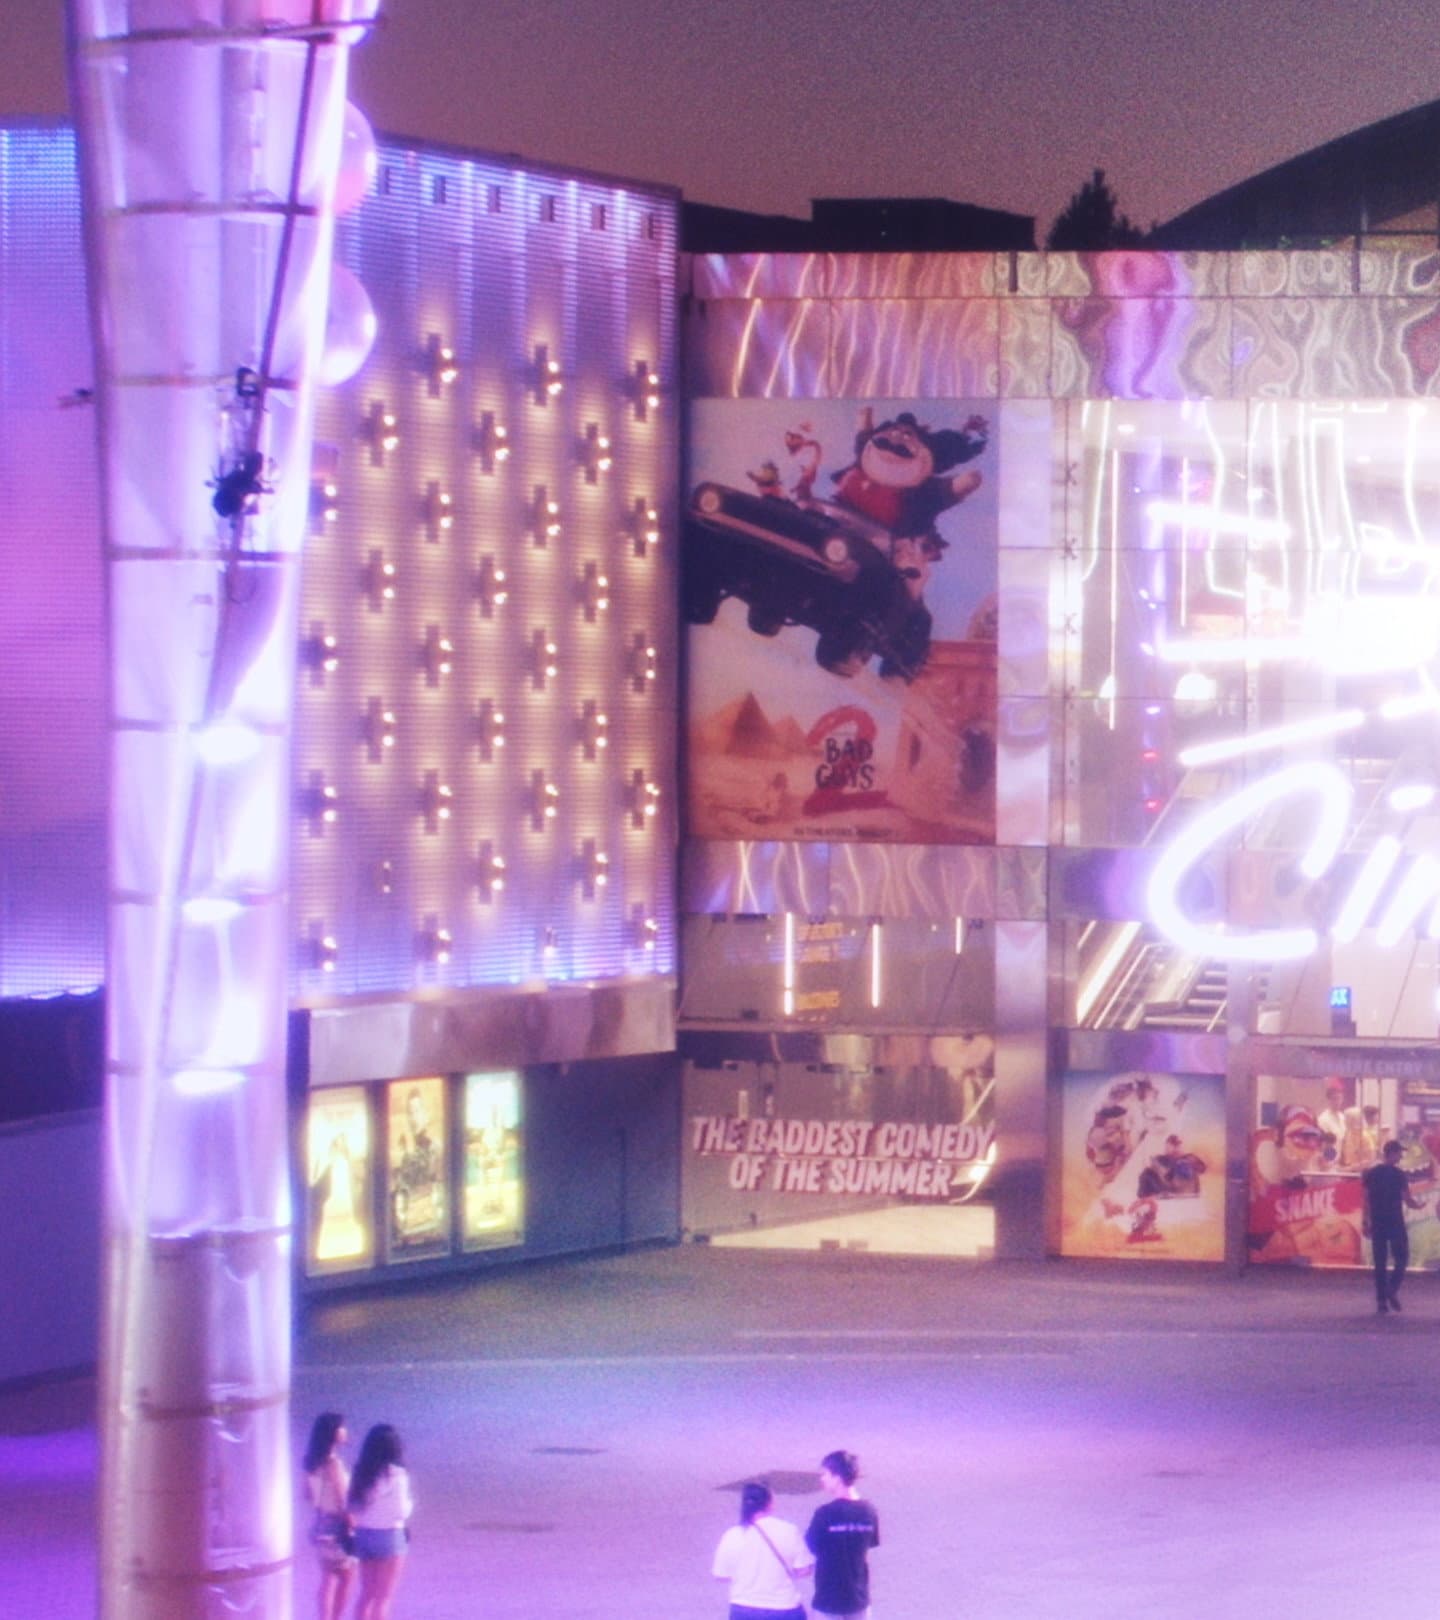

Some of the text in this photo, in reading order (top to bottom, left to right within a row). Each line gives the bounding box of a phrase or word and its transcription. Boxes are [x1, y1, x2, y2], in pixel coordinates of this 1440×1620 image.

[825, 737, 873, 763] BAD
[692, 1116, 995, 1161] THE BADDEST COMEDY
[729, 1154, 952, 1196] OF THE SUMMER
[1274, 1187, 1336, 1223] SNAKE
